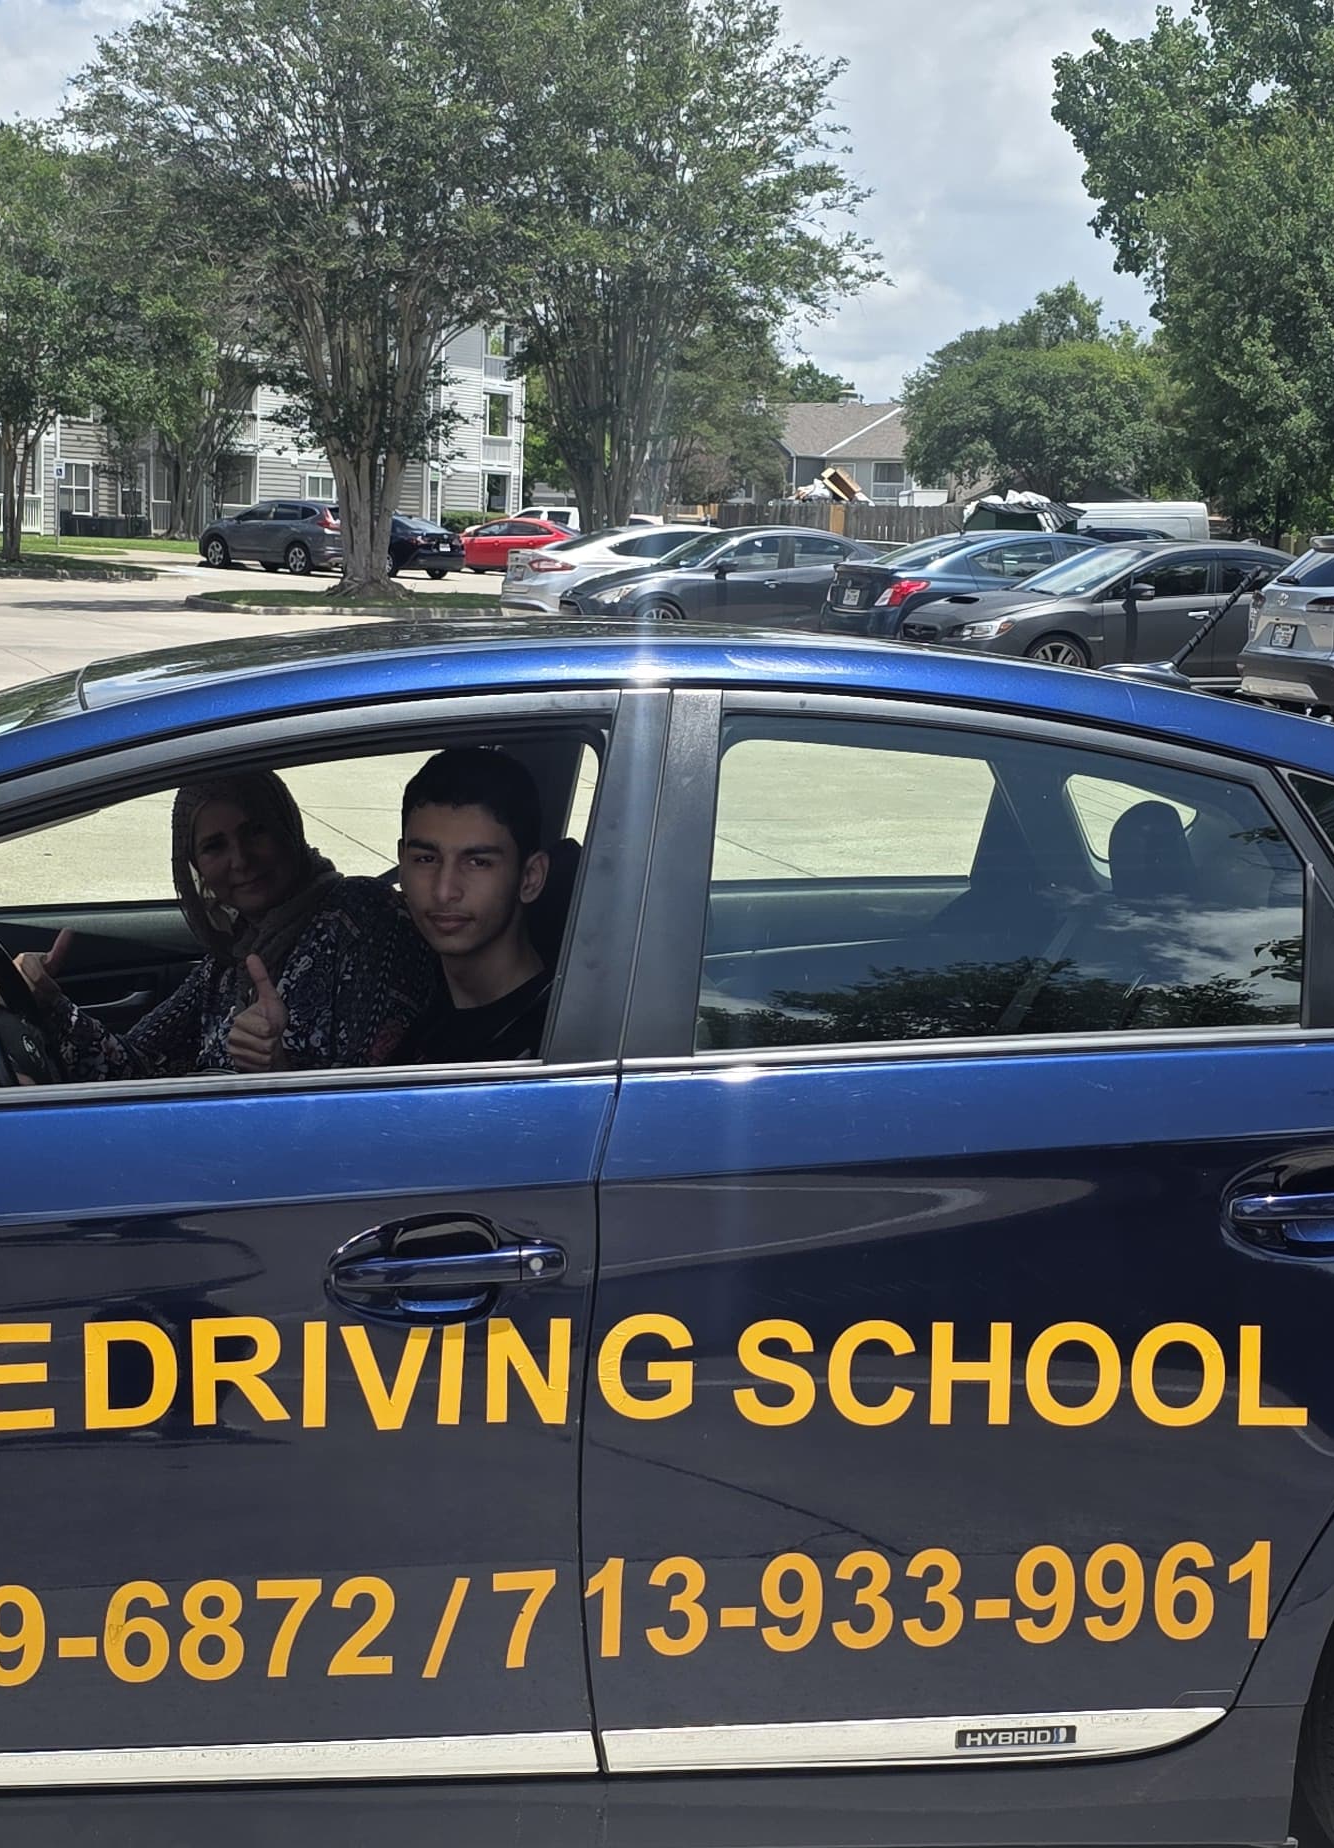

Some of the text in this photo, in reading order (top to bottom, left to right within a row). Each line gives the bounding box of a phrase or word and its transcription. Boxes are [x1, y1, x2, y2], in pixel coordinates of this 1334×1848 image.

[84, 1312, 695, 1431] DRIVING
[732, 1318, 1309, 1428] SCHOOL
[492, 1540, 1273, 1670] 713-933-9961
[965, 1729, 1052, 1747] HYBRID
